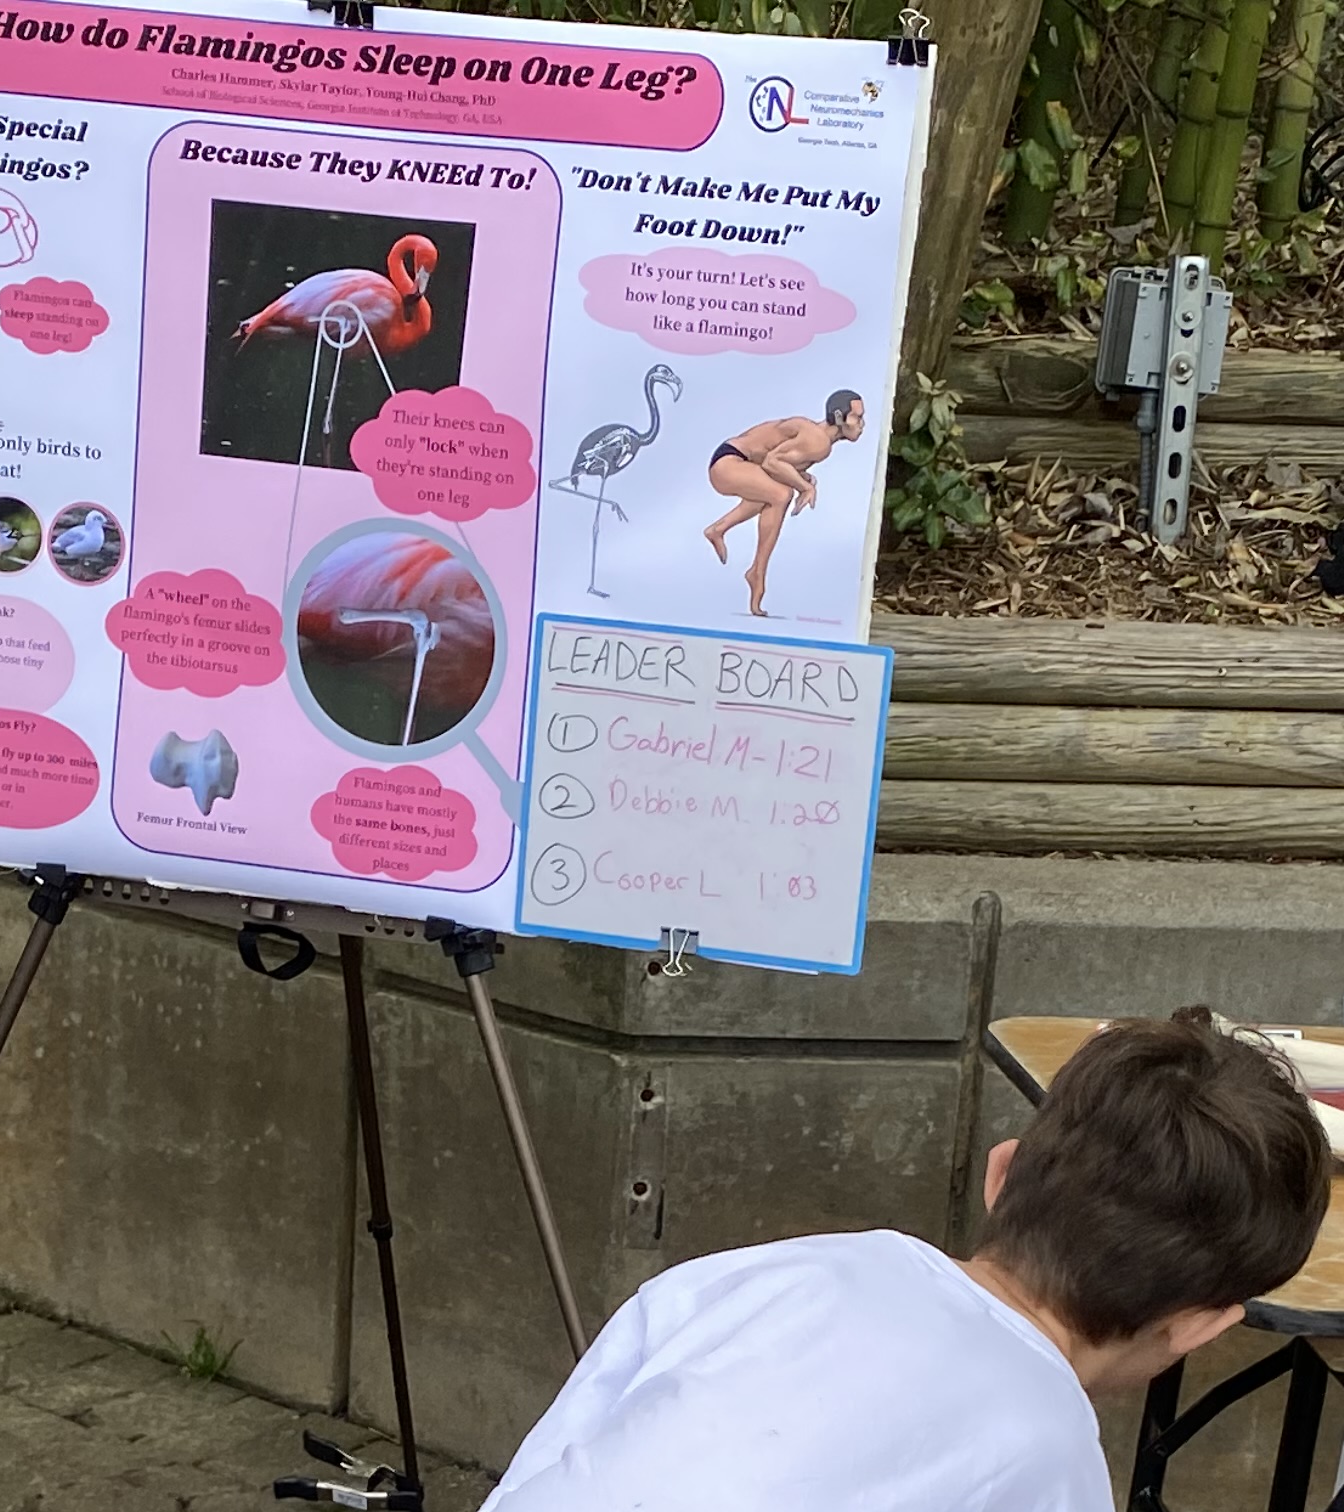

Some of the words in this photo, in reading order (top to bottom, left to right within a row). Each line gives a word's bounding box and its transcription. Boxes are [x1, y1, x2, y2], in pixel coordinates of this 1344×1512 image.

[81, 18, 129, 49] do
[135, 23, 347, 73] Flamingos
[353, 44, 455, 86] Sleep
[463, 56, 513, 83] on
[520, 56, 594, 87] One
[599, 62, 697, 100] Leg?
[171, 68, 216, 83] Charles
[472, 95, 496, 107] PhD
[804, 90, 860, 104] Comparative
[810, 104, 884, 118] Neuromechanics
[817, 118, 864, 131] Laboratory
[179, 138, 302, 171] Because
[309, 150, 382, 182] They
[386, 159, 484, 187] KNEEd
[490, 166, 537, 190] To!
[571, 167, 651, 193] "Don't
[656, 174, 732, 199] Make
[736, 182, 779, 203] Me
[783, 185, 833, 209] Put
[835, 190, 881, 216] My
[634, 213, 697, 238] Foot
[700, 219, 804, 245] Down!"
[631, 262, 653, 278] It's
[657, 267, 693, 282] your
[697, 271, 736, 285] turn!
[740, 273, 776, 289] Let's
[780, 279, 805, 291] see
[625, 288, 658, 304] how
[661, 290, 695, 310] long
[699, 296, 727, 311] you
[731, 300, 759, 313] can
[763, 301, 806, 318] stand
[653, 315, 682, 332] like
[686, 321, 694, 333] a
[698, 319, 774, 342] flamingo!
[393, 409, 430, 426] Their
[433, 413, 475, 431] knees
[480, 421, 505, 434] can
[36, 439, 80, 457] birds
[85, 446, 102, 460] to
[385, 435, 415, 454] only
[420, 437, 464, 455] "lock"
[468, 444, 509, 459] when
[377, 458, 425, 476] they're
[429, 463, 491, 485] standing
[495, 471, 514, 484] on
[417, 490, 444, 502] one
[449, 490, 469, 508] leg
[145, 588, 155, 599] A
[158, 588, 209, 606] "wheel"
[212, 598, 227, 609] on
[231, 599, 251, 612] the
[124, 605, 189, 626] flamingo's
[194, 614, 231, 630] femur
[235, 620, 271, 635] slides
[5, 636, 24, 649] that
[28, 639, 50, 652] feed
[121, 628, 179, 648] perfectly
[182, 633, 194, 646] in
[198, 640, 204, 648] a
[208, 641, 250, 655] groove
[254, 646, 270, 656] on
[147, 653, 167, 665] the
[170, 654, 238, 674] tibiotarsus
[547, 631, 695, 687] LEADER
[715, 652, 860, 707] BOARD
[14, 719, 36, 733] Fly?
[607, 715, 717, 765] Gabriel
[353, 776, 416, 797] Flamingos
[419, 785, 441, 798] and
[609, 775, 697, 813] Debbie
[334, 794, 383, 812] humans
[386, 799, 415, 814] have
[417, 805, 458, 822] mostly
[137, 812, 174, 827] Femur
[176, 815, 217, 832] Frontal
[220, 821, 248, 835] View
[333, 812, 352, 826] the
[356, 818, 388, 831] same
[390, 820, 430, 837] bones,
[433, 826, 455, 839] just
[338, 833, 391, 850] different
[393, 842, 422, 854] sizes
[424, 844, 447, 857] and
[372, 857, 409, 872] places
[593, 850, 688, 892] Cooper
[700, 870, 721, 898] L
